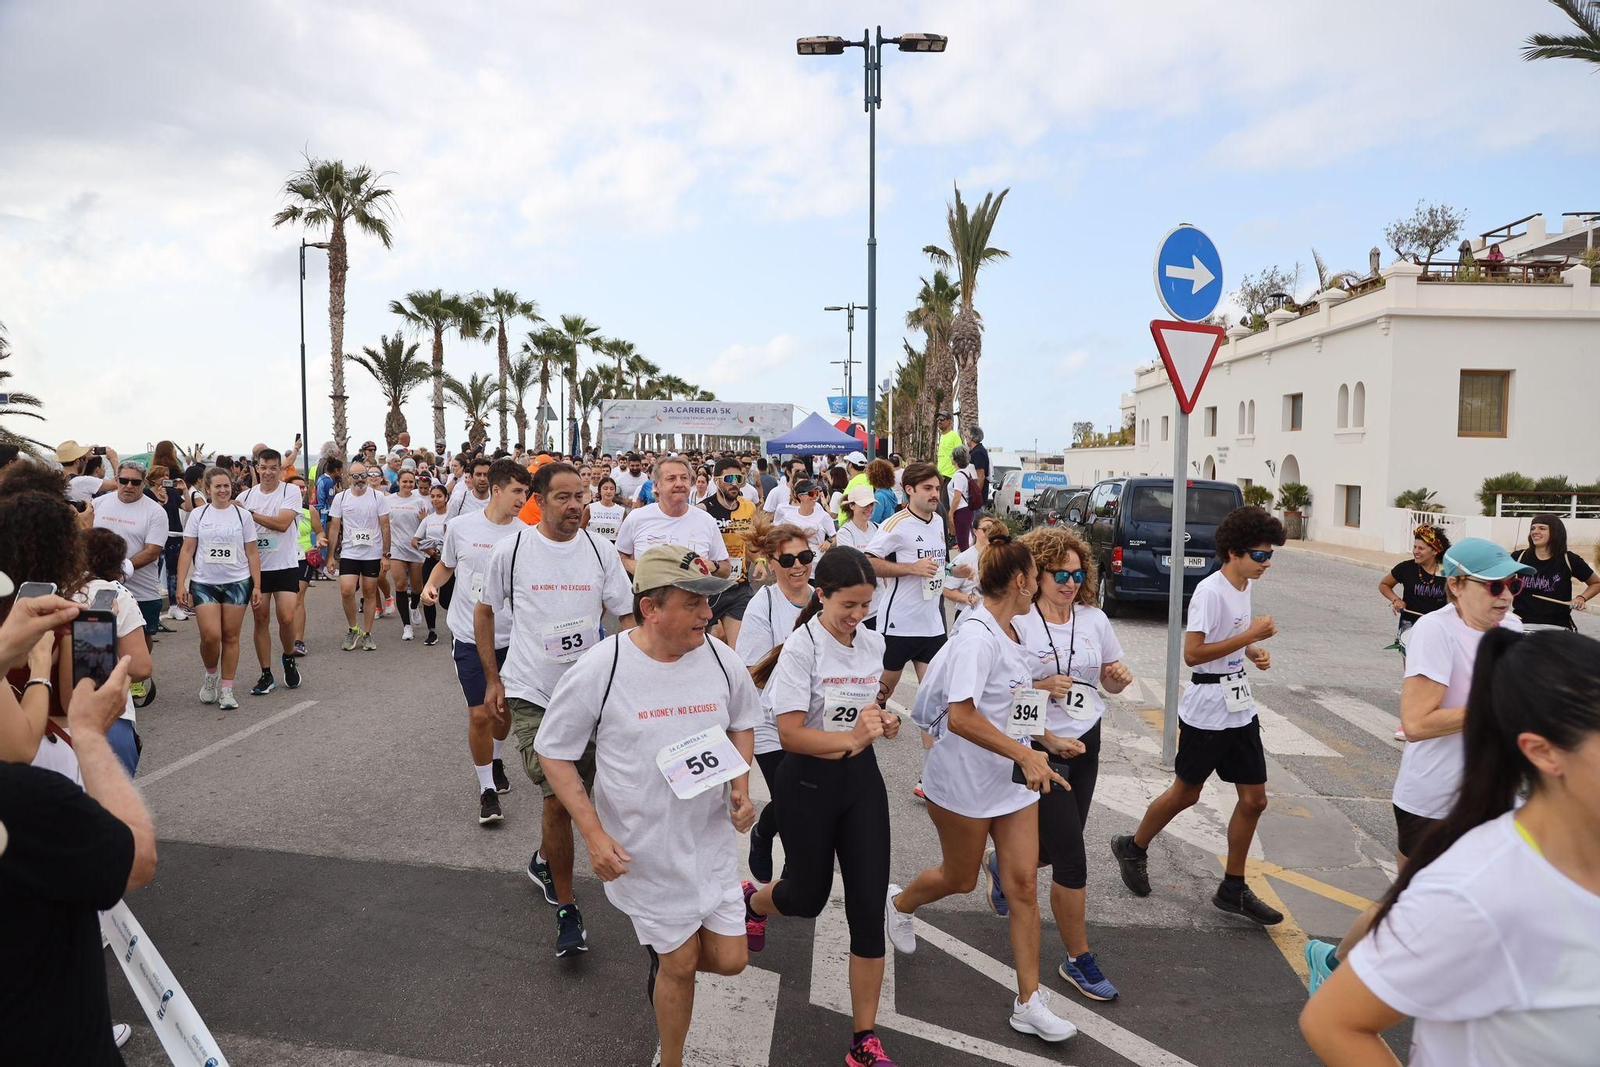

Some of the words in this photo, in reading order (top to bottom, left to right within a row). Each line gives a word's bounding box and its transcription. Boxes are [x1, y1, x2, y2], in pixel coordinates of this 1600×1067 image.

[676, 406, 718, 414] CARRERA
[356, 533, 370, 541] 925
[210, 549, 230, 557] 238
[562, 633, 583, 650] 53
[638, 711, 648, 720] NO
[678, 706, 687, 714] NO
[832, 706, 858, 722] 29
[1014, 704, 1038, 720] 394
[686, 751, 719, 775] 56
